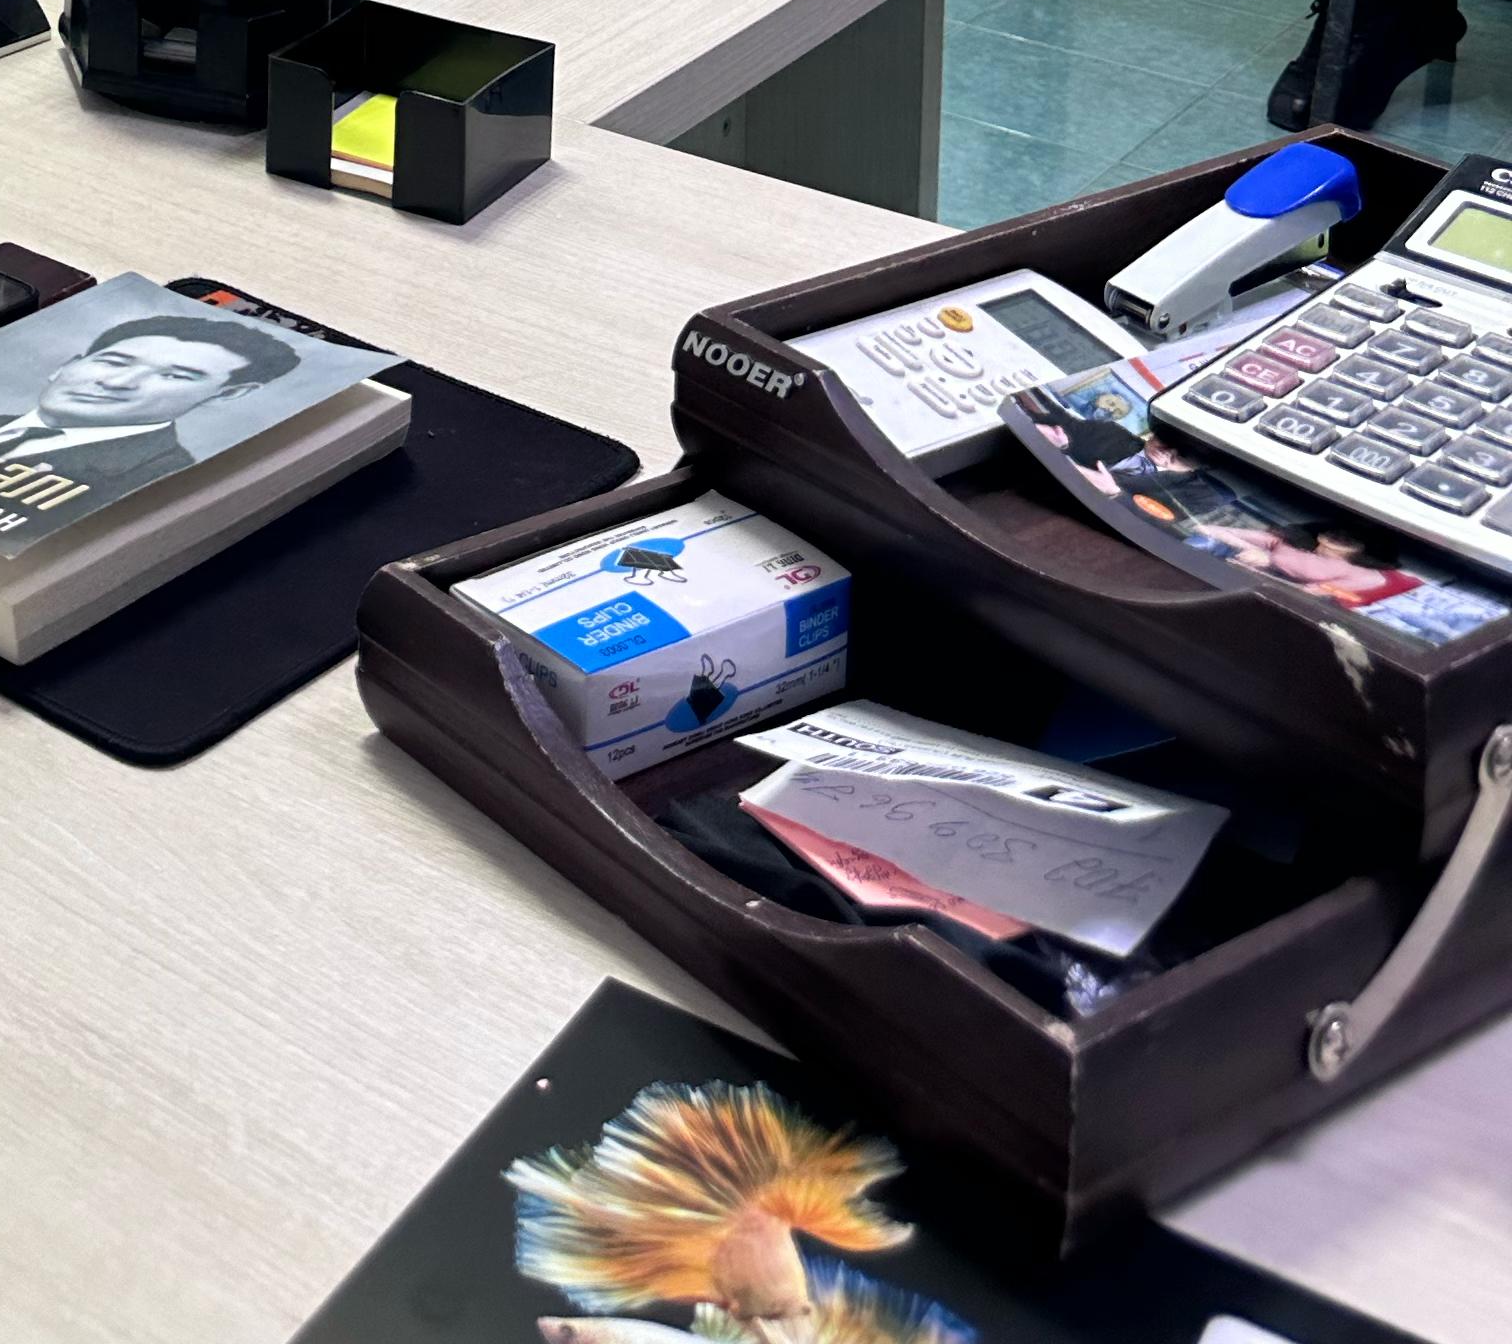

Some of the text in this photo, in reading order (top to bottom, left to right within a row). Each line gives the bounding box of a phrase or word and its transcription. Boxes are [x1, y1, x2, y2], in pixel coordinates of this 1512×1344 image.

[1279, 339, 1316, 355] AC
[1391, 342, 1417, 356] 7
[682, 330, 794, 400] NOOER
[1241, 363, 1280, 379] CE
[1356, 371, 1381, 384] 4
[1463, 369, 1487, 384] 8
[1211, 390, 1235, 404] 0
[1326, 396, 1343, 409] 1
[1429, 395, 1453, 410] 5
[1276, 417, 1315, 436] 00
[1394, 423, 1417, 434] 2
[577, 601, 633, 628] CLIPS
[800, 606, 839, 633] BINDER
[577, 612, 651, 646] BINDER
[799, 625, 829, 648] CLIPS
